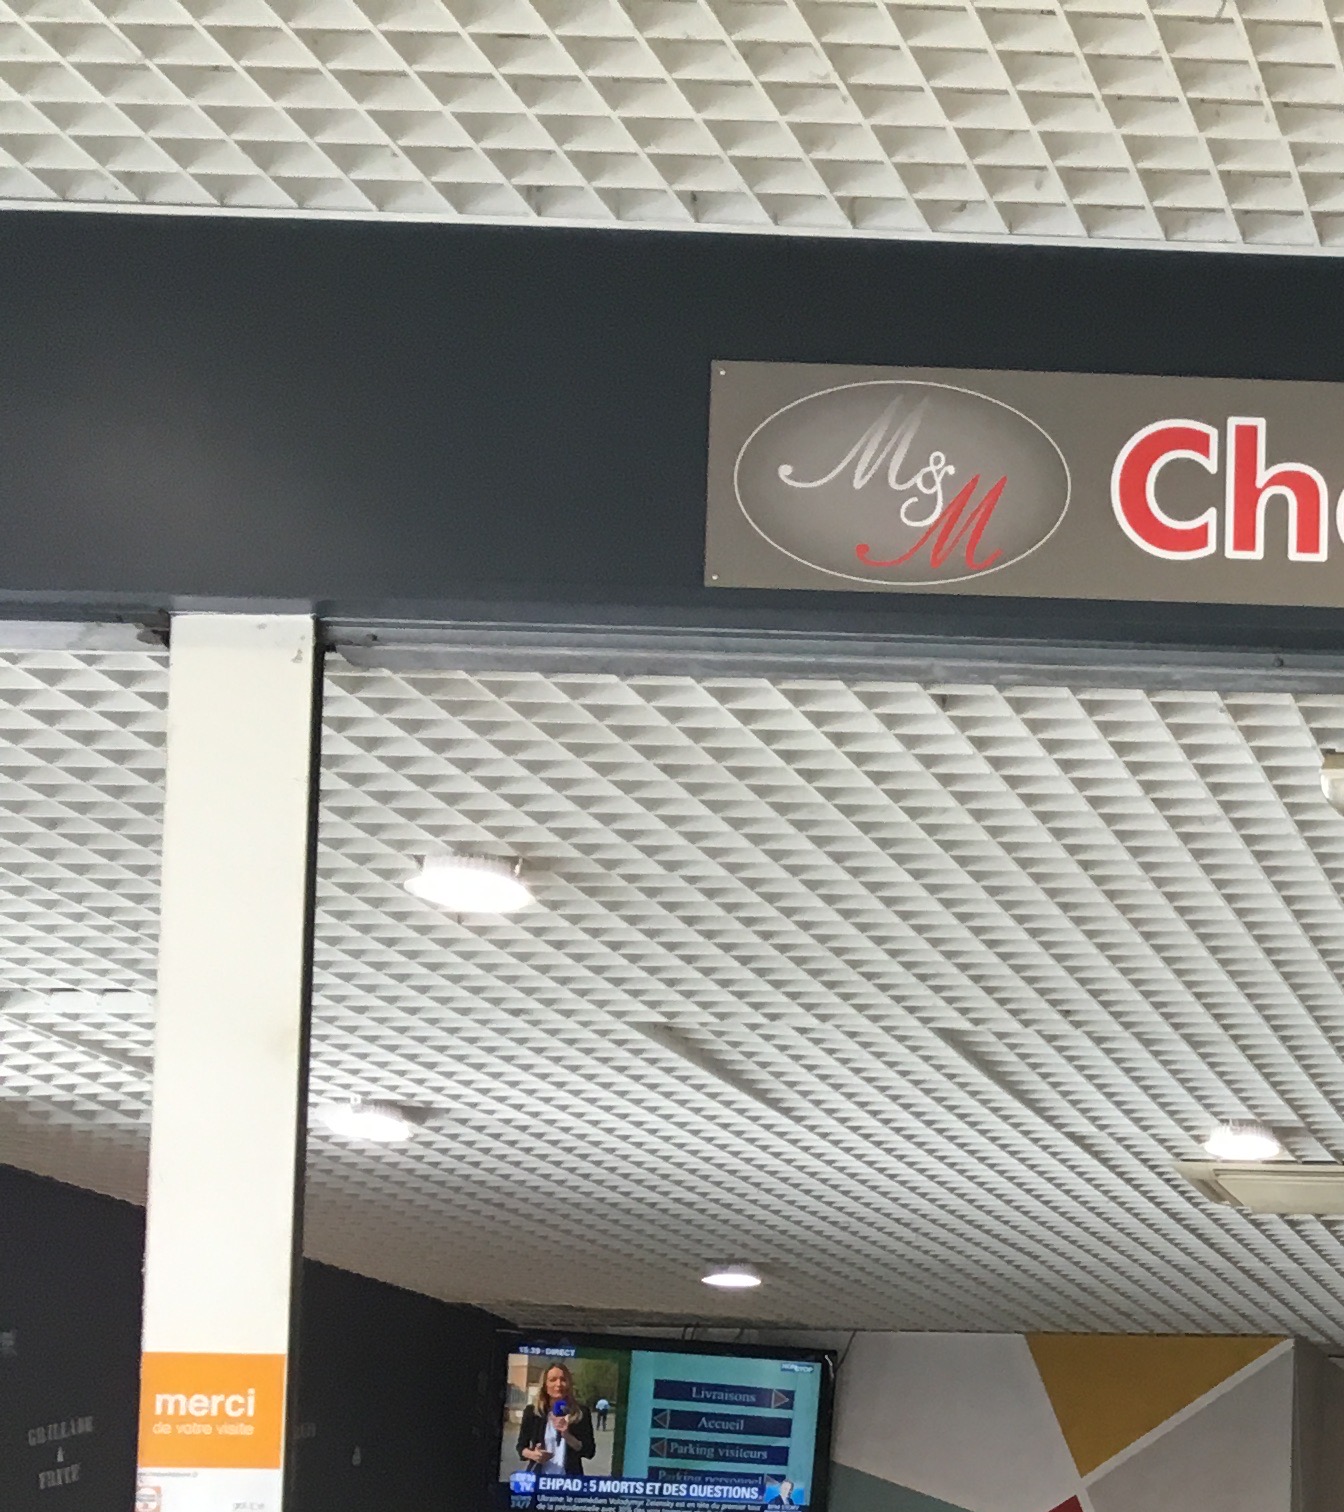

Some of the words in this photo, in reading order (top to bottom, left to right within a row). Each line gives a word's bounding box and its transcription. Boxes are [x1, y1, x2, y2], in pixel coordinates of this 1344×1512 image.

[154, 1388, 256, 1417] merci
[692, 1386, 756, 1403] Livraisons
[153, 1423, 171, 1435] de
[176, 1423, 213, 1435] votre
[216, 1422, 255, 1435] visite
[698, 1417, 744, 1431] Accueil
[670, 1441, 714, 1458] Parking
[719, 1446, 768, 1460] visiteurs
[539, 1477, 582, 1491] EHPAD
[589, 1480, 597, 1492] 5
[598, 1480, 644, 1495] MORTS
[646, 1483, 661, 1495] ET
[663, 1483, 687, 1496] DES
